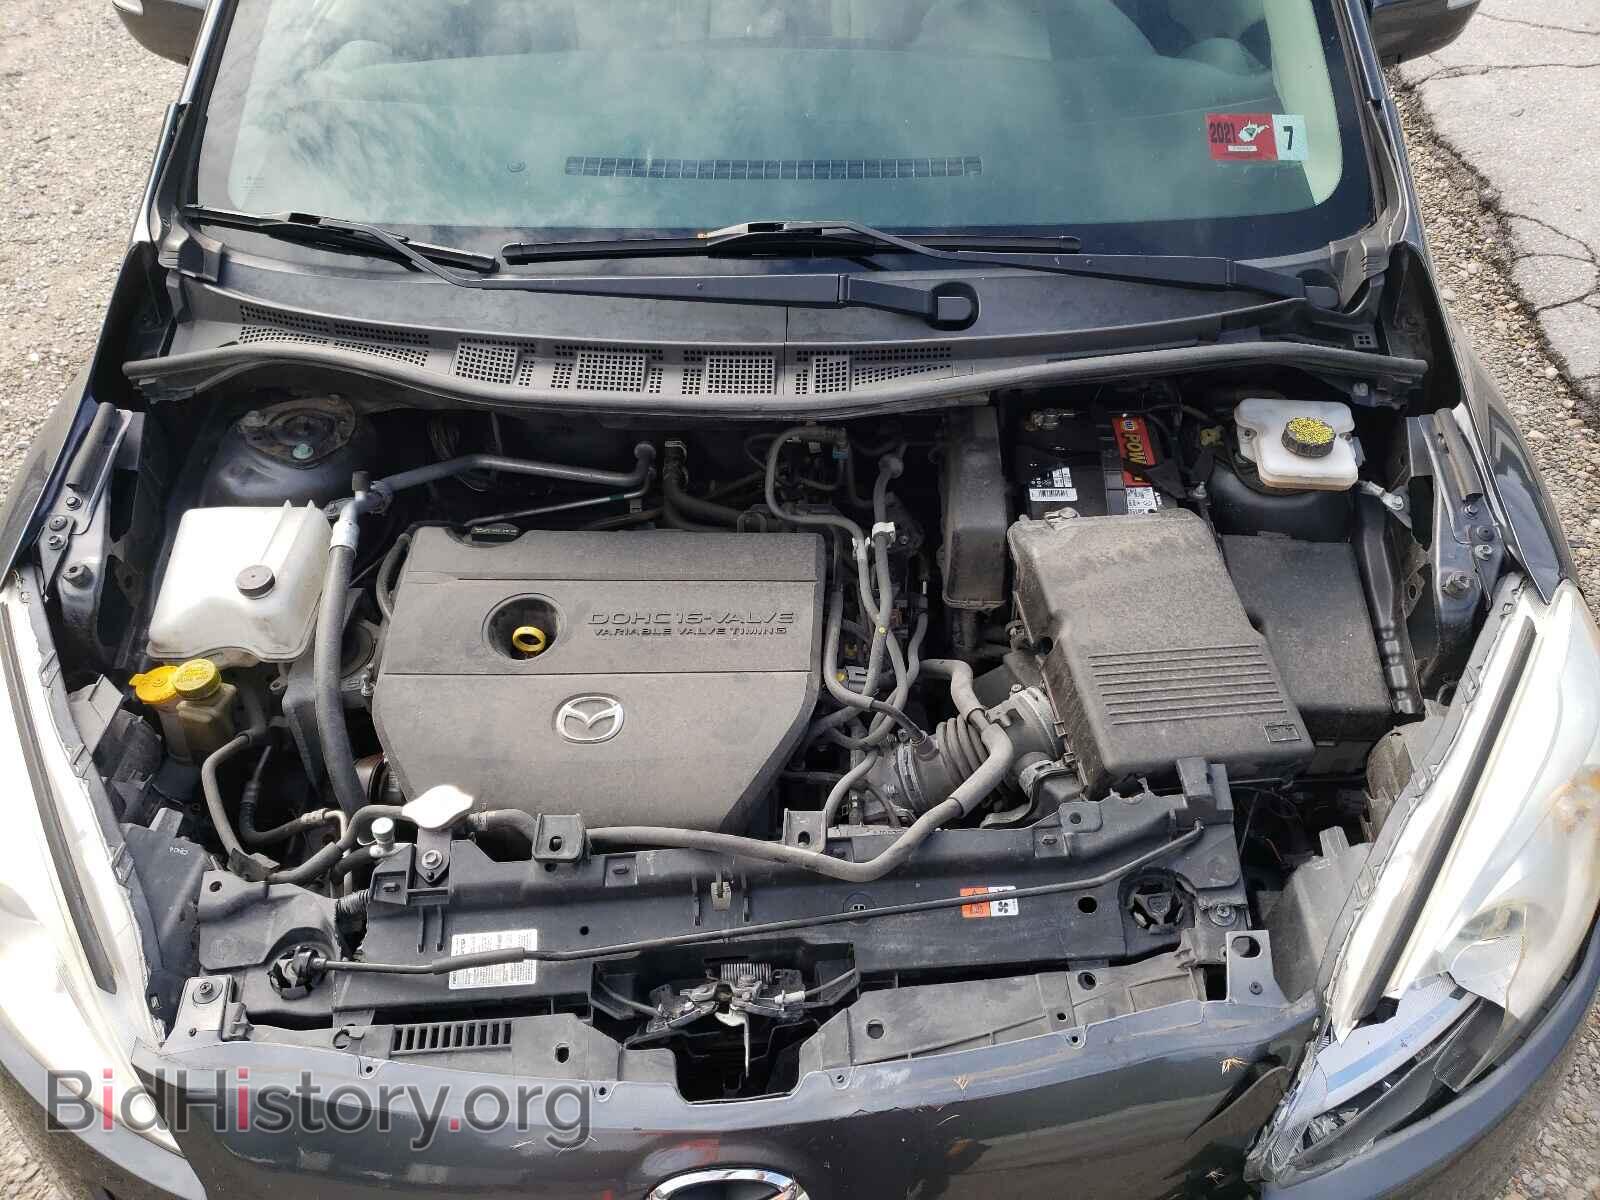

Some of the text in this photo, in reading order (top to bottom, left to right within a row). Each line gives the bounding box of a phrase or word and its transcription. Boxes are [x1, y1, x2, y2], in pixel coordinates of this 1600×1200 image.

[1209, 122, 1236, 143] 2021
[1283, 125, 1293, 150] 7
[1122, 432, 1148, 481] POW
[588, 611, 793, 624] DOHC 16-VALVE
[595, 626, 787, 636] VARIABLE VALVE TIMING
